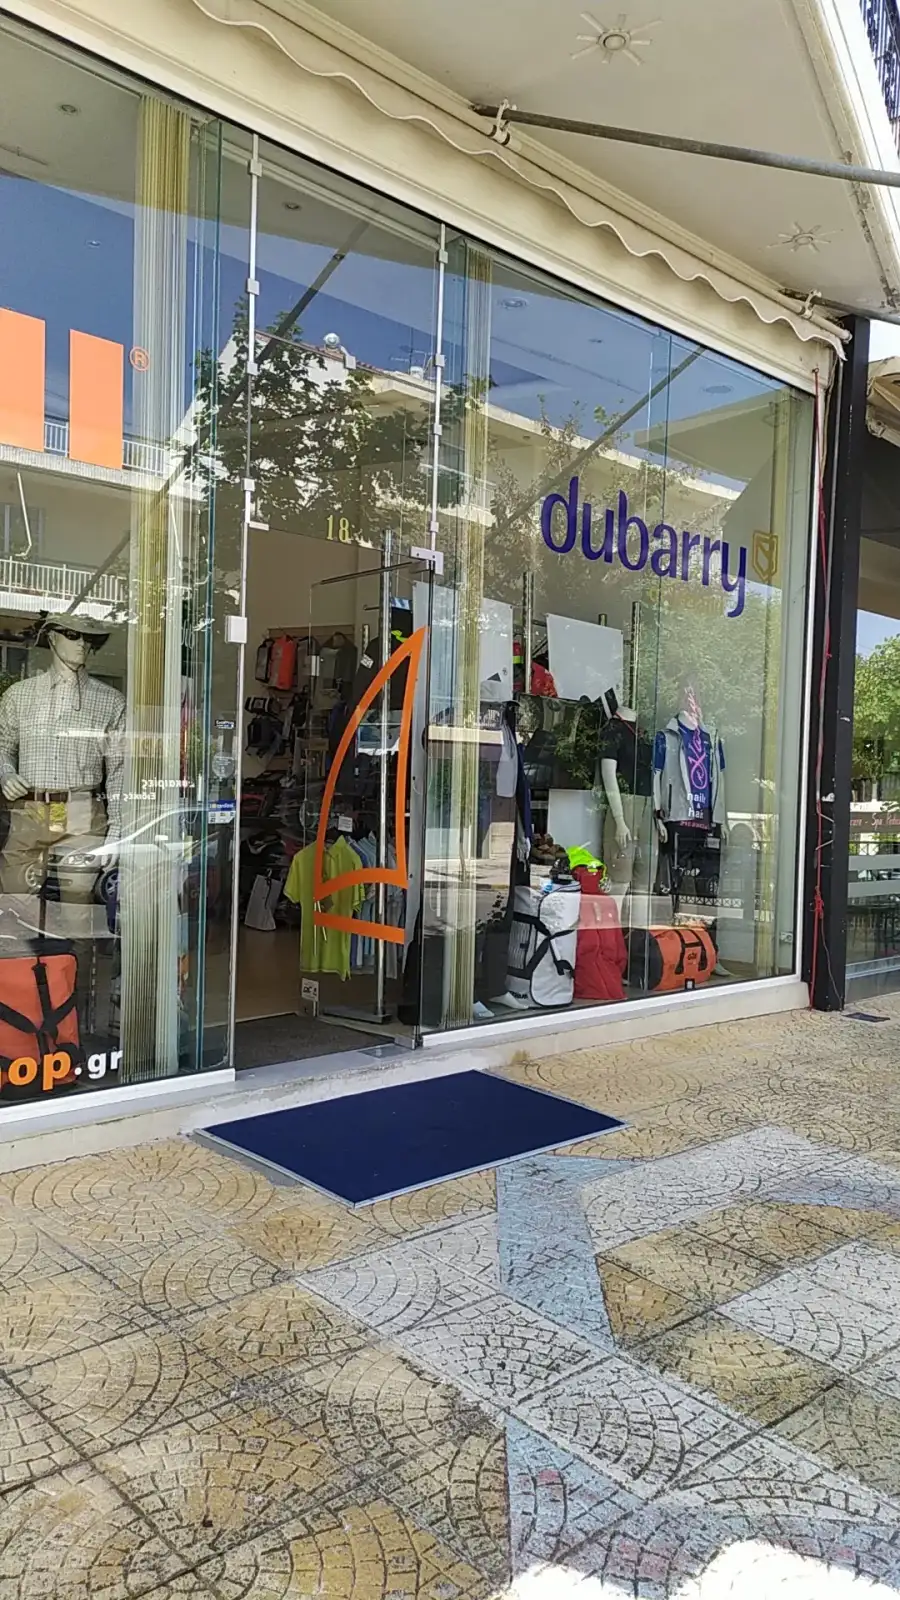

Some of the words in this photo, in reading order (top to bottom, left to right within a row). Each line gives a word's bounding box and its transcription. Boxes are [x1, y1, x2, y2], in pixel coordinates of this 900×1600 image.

[327, 514, 350, 543] 18
[541, 476, 747, 618] dubarry
[0, 1049, 123, 1091] op.gr
